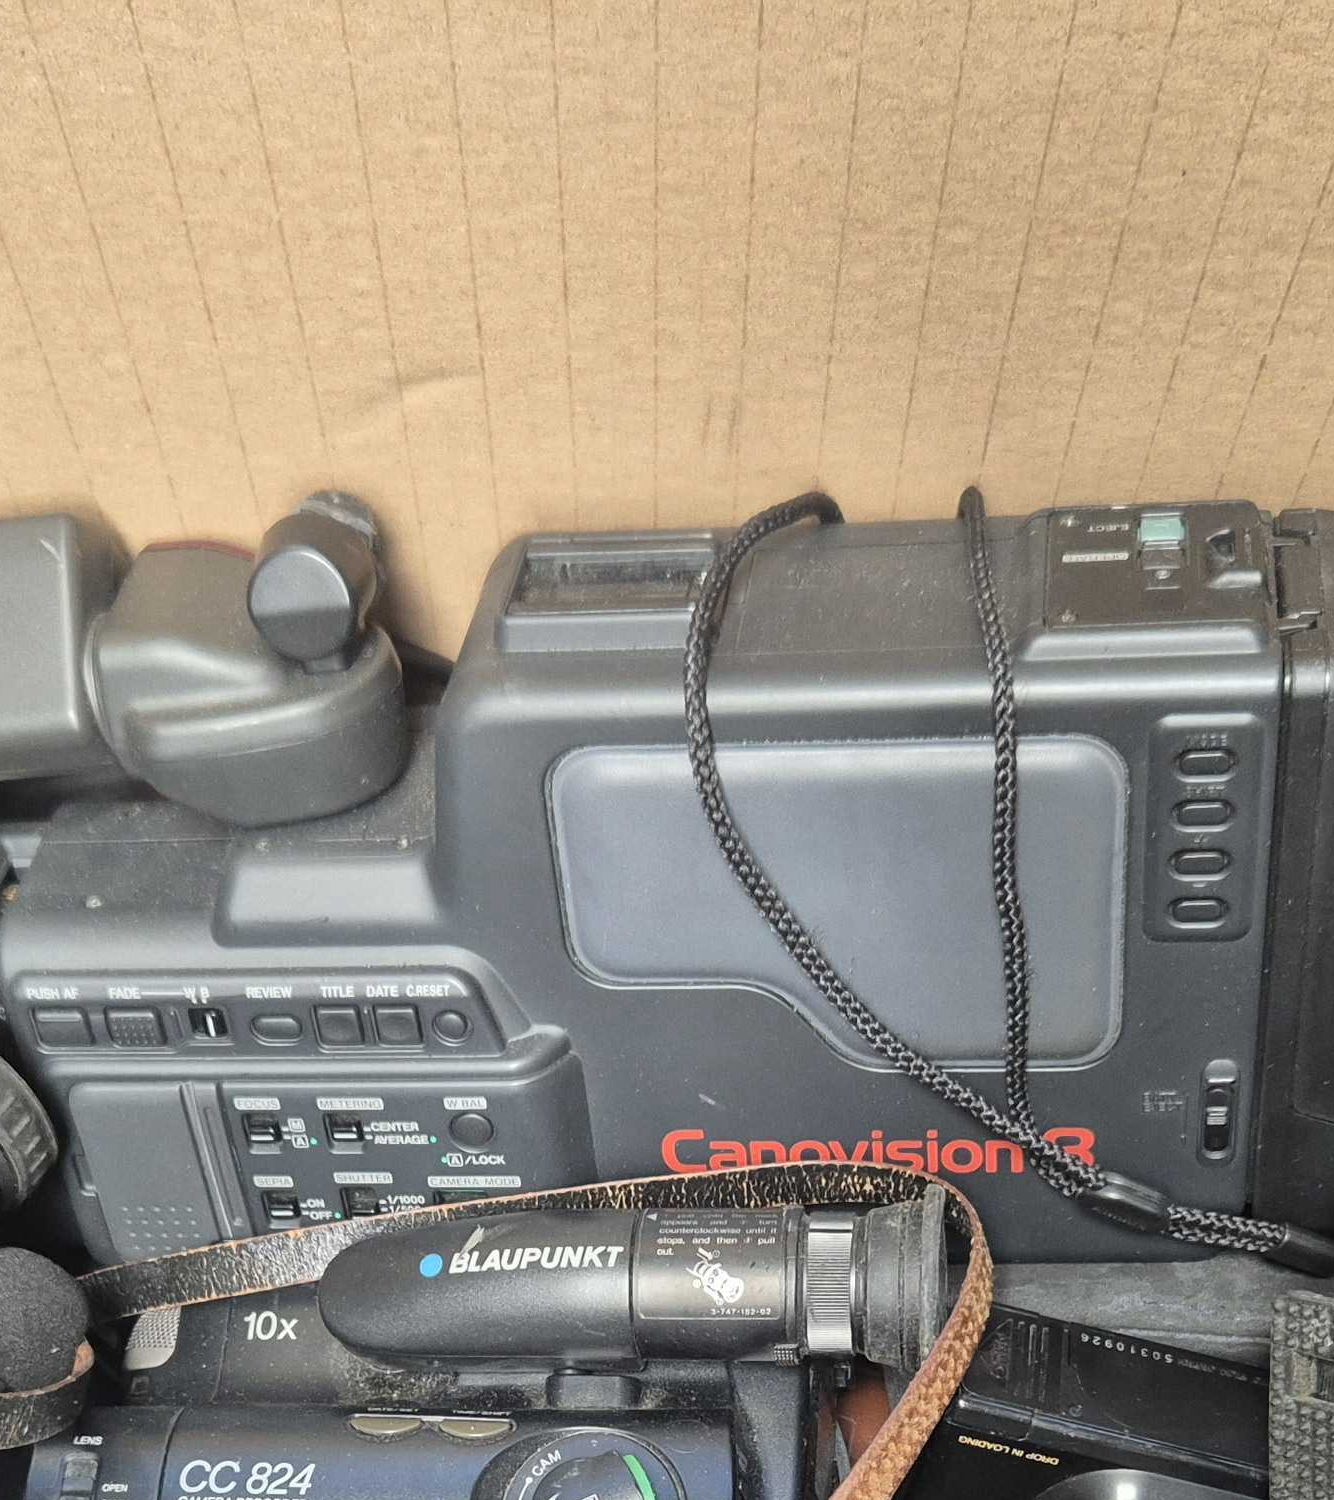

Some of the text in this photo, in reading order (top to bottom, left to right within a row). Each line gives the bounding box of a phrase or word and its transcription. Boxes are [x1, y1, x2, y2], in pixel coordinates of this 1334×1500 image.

[26, 986, 79, 1000] PUSH AF
[107, 986, 142, 1000] FADE
[245, 986, 292, 999] REVIEW
[320, 985, 355, 998] TITLE
[366, 985, 400, 997] DATE
[236, 1099, 279, 1109] FOCUS
[319, 1098, 382, 1109] METERING
[370, 1122, 420, 1132] CENTER
[373, 1134, 430, 1145] AVERAGE
[661, 1129, 1025, 1174] Canovision
[255, 1176, 293, 1186] SEPIA
[336, 1173, 391, 1184] SHUTTER
[429, 1176, 520, 1187] CAMERA MODE
[307, 1198, 325, 1208] ON
[386, 1194, 425, 1205] 1/1000
[310, 1211, 333, 1221] OFF
[658, 1227, 742, 1235] counterclockwise
[692, 1236, 711, 1245] and
[717, 1236, 738, 1245] then
[757, 1236, 776, 1246] pull
[447, 1246, 625, 1275] BLAUPUNKT
[243, 1310, 299, 1341] 10x
[1080, 1331, 1174, 1364] 50310926
[72, 1435, 104, 1447] LENS
[957, 1434, 1060, 1467] DROP IN LOADING
[531, 1449, 563, 1478] CAM
[178, 1458, 317, 1496] CC 824
[101, 1483, 129, 1493] OPEN
